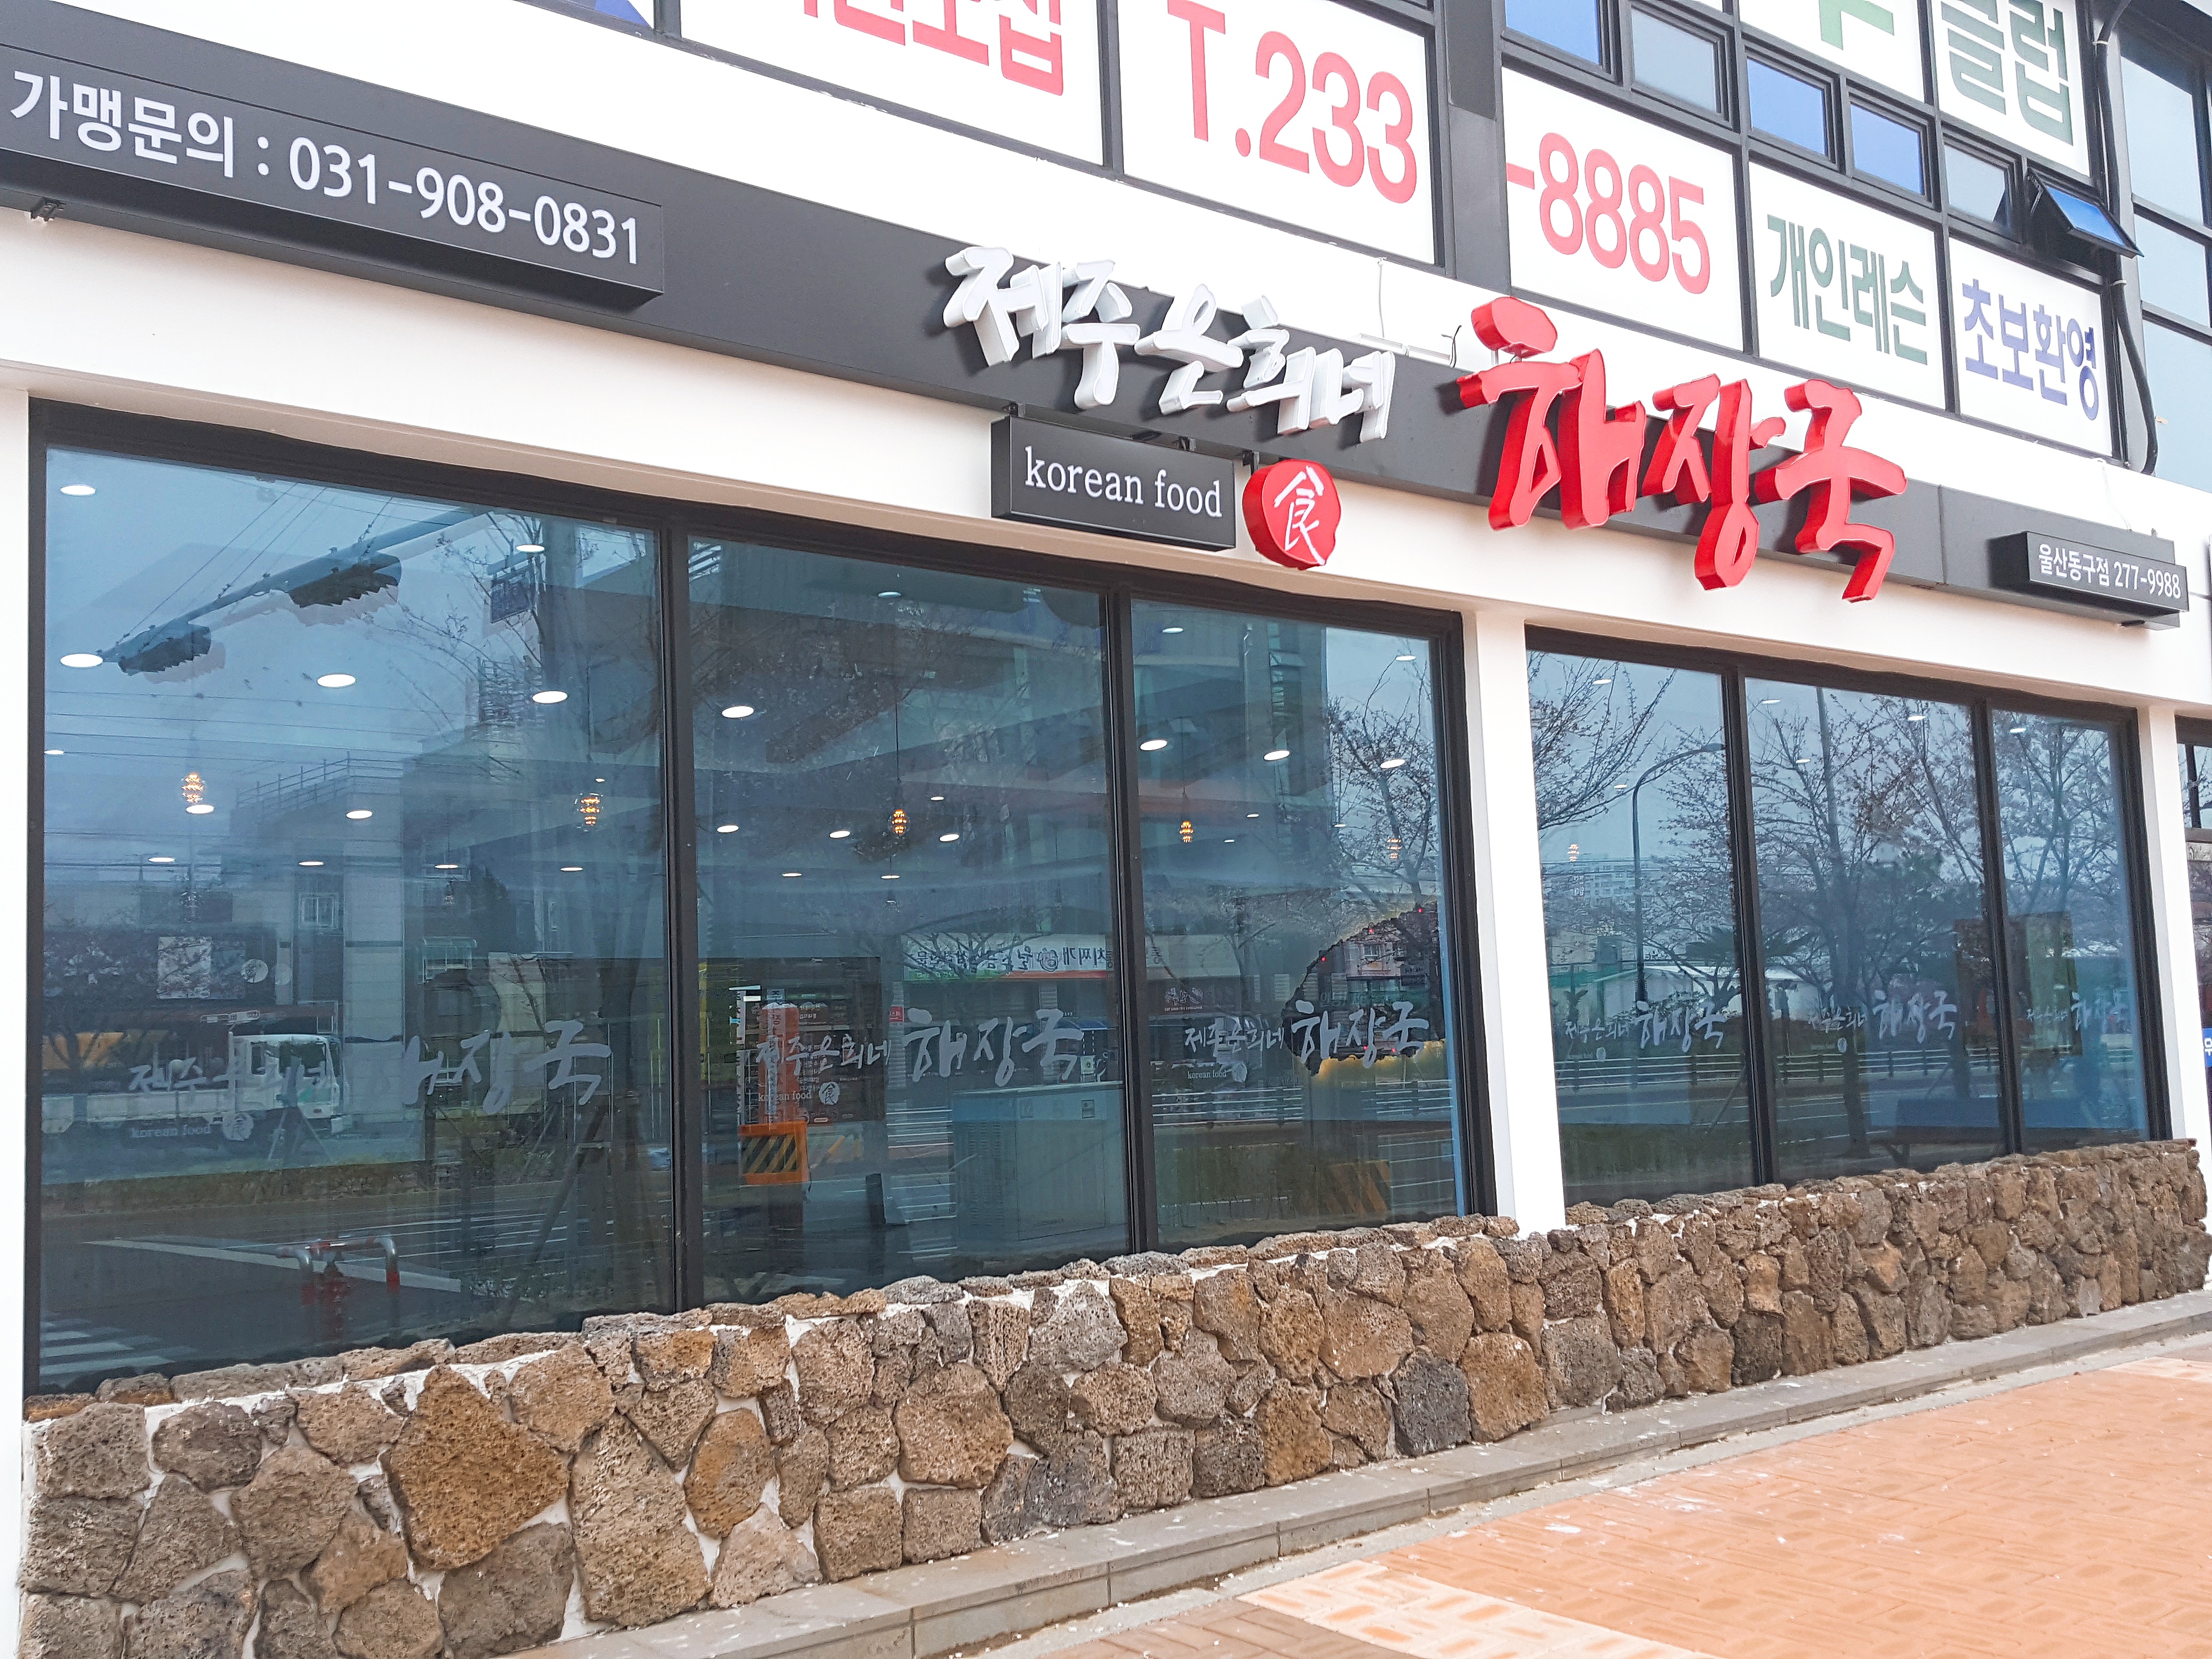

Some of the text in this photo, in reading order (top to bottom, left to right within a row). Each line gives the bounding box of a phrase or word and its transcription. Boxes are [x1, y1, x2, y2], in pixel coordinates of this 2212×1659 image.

[10, 70, 234, 178] 가맹문의
[289, 136, 639, 265] 031-908-0831
[1767, 214, 1928, 365] 개인레슨
[1962, 278, 2099, 421] 초보환영
[944, 246, 1908, 604] 제주은희네 해장국
[1025, 446, 1223, 519] korean food
[1273, 465, 1326, 567] 食
[2038, 544, 2181, 599] 울산동구점 277-9988
[902, 1007, 1084, 1087] 해장국
